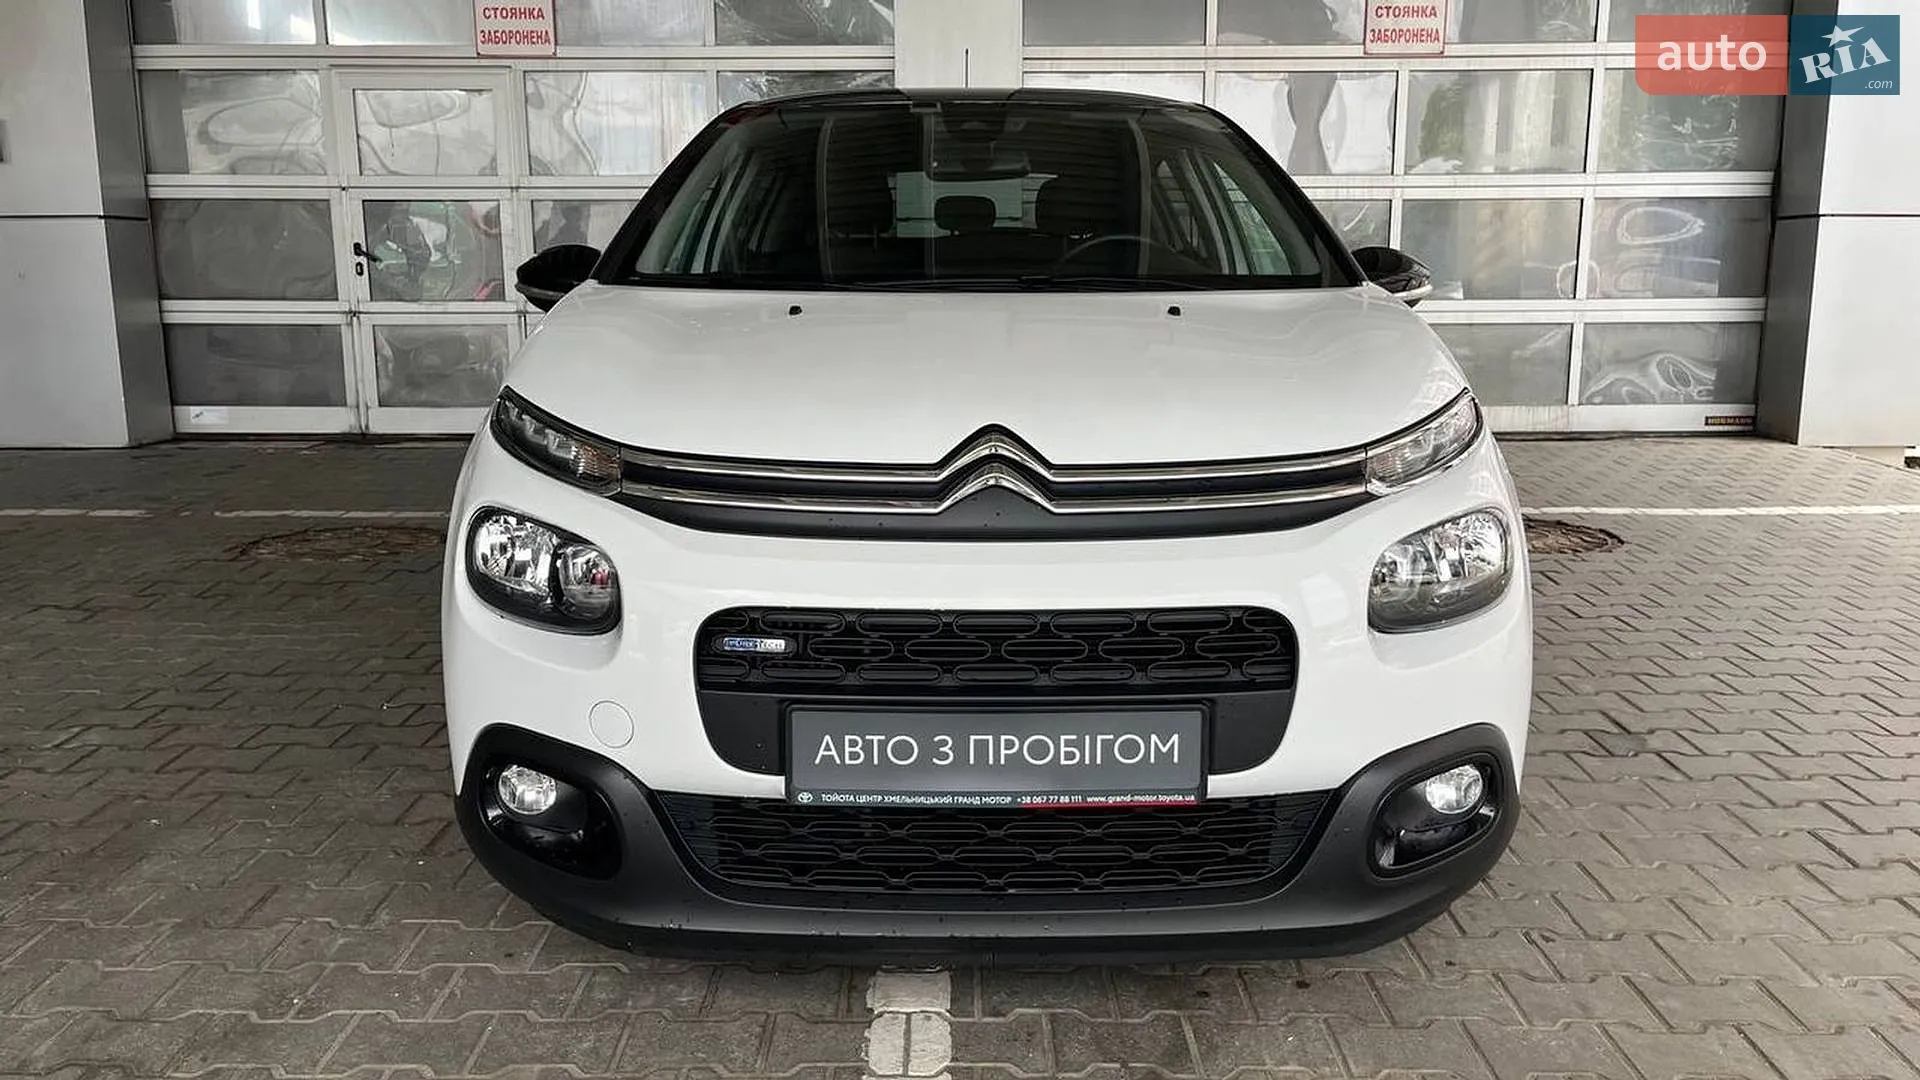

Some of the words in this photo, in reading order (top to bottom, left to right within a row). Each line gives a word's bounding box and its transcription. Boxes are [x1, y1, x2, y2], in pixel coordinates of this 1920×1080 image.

[482, 7, 545, 20] СТОЯНКА
[1375, 5, 1437, 18] СТОЯНКА
[480, 30, 551, 45] ЗАБОРОНЕНА
[1369, 28, 1440, 43] ЗАБОРОНЕНА
[814, 734, 919, 765] АВТО
[969, 734, 1179, 765] ПРОБІГОМ
[821, 792, 855, 802] ТОЙОТА
[856, 794, 883, 803] ЦЕНТР
[954, 795, 980, 805] ГРАНД
[981, 796, 1012, 804] МОТОР
